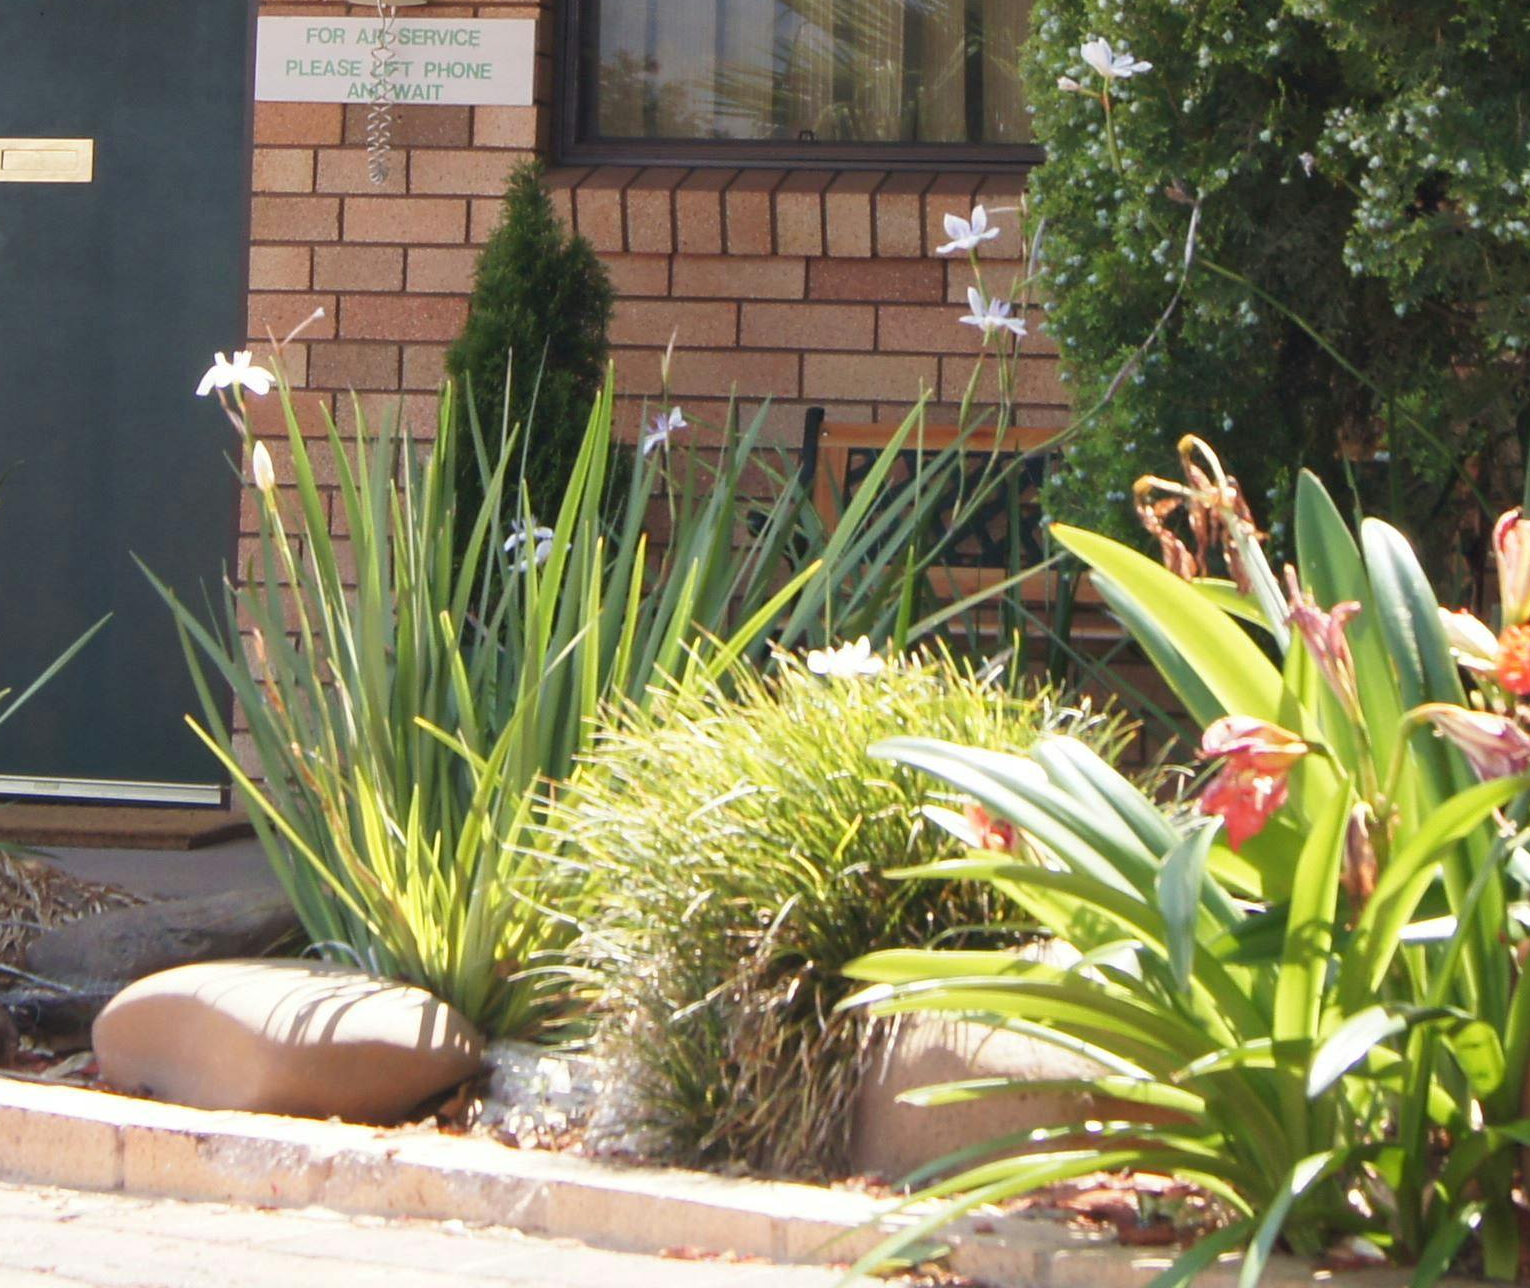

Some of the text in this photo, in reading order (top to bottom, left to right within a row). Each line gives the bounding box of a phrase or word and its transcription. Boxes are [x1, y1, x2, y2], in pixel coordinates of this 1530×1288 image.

[306, 27, 345, 44] FOR
[398, 28, 481, 47] SERVICE
[286, 59, 361, 76] PLEASE
[424, 61, 493, 79] PHONE
[393, 83, 444, 100] WAIT
